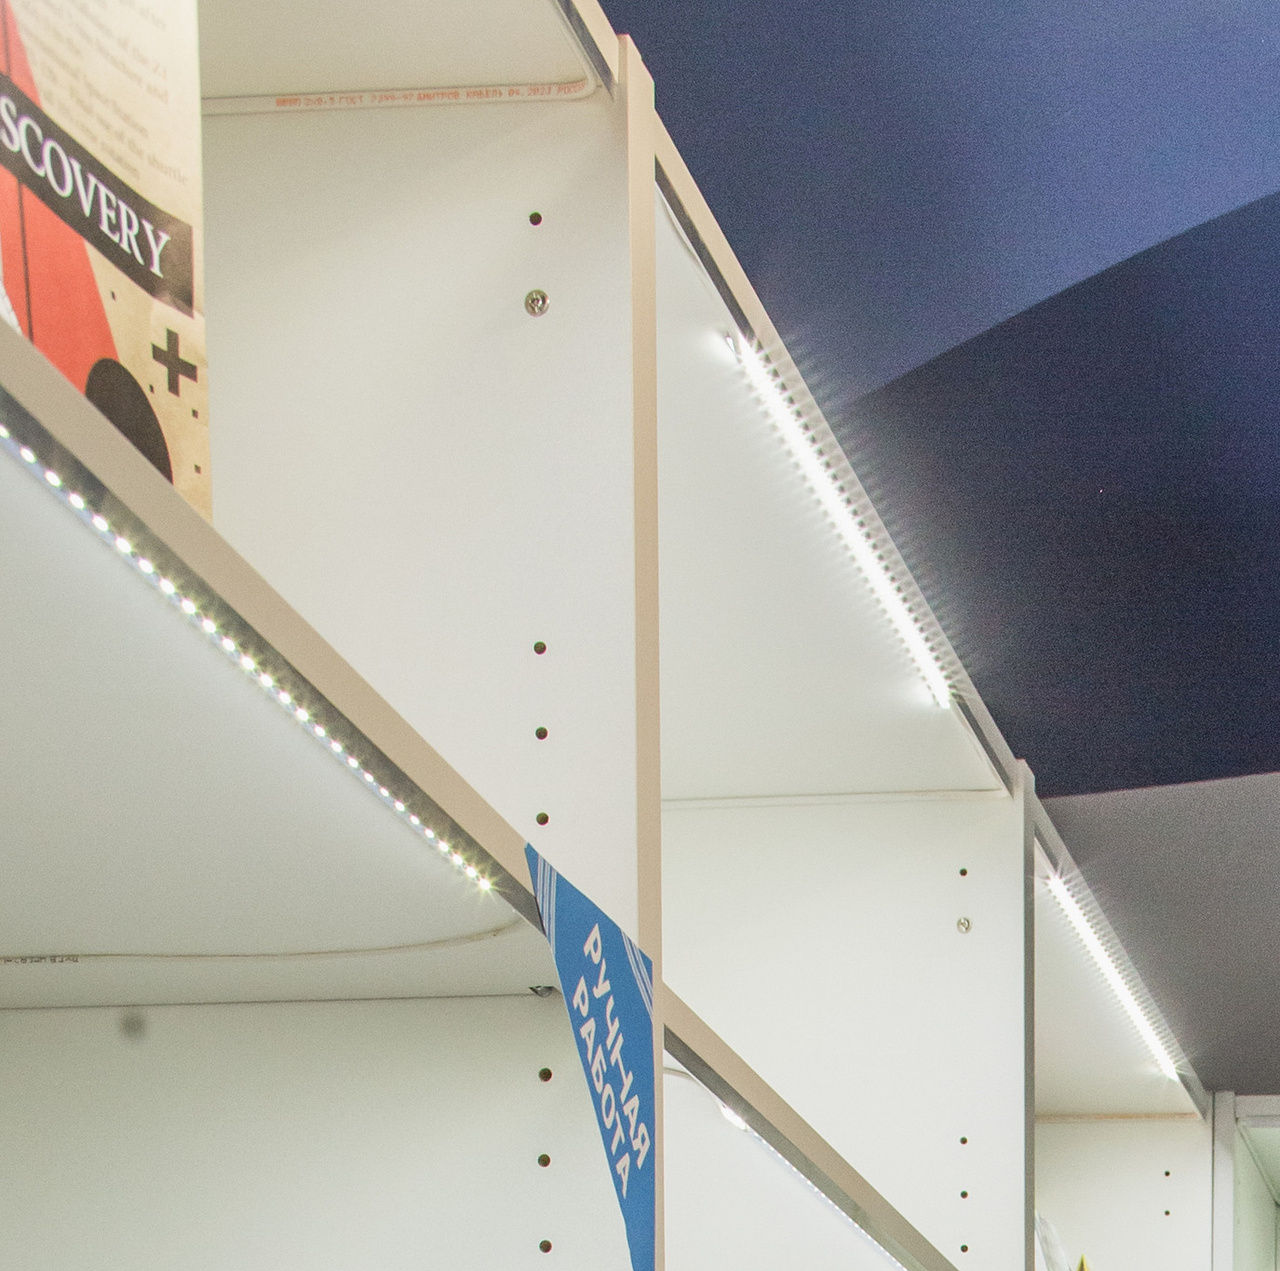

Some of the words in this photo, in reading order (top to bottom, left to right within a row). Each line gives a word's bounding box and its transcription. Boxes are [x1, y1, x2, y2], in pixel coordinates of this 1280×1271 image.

[0, 95, 171, 278] SCOVERY
[572, 976, 629, 1199] РАБОТА
[583, 923, 650, 1170] РУЧНАЯ
